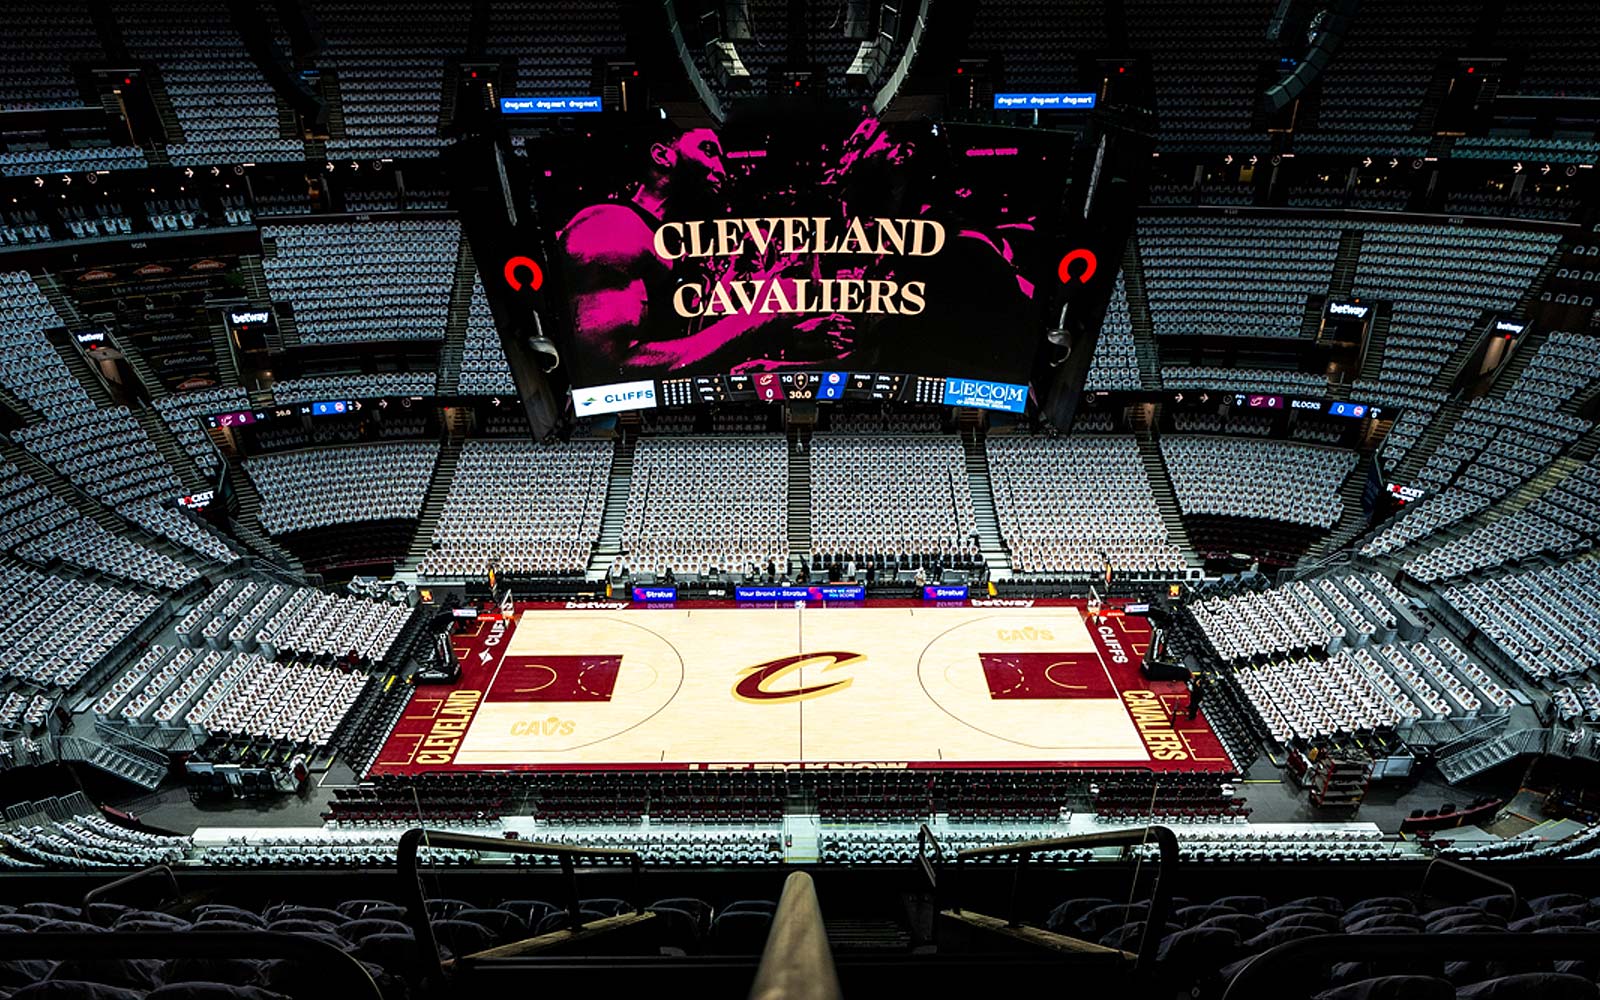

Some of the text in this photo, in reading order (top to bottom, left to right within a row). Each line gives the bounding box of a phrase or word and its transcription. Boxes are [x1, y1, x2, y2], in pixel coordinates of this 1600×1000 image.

[653, 216, 946, 260] CLEVELAND
[673, 278, 926, 318] CAVALIERS
[1330, 302, 1369, 318] betway
[231, 312, 269, 324] betway
[1496, 321, 1525, 334] betway
[77, 332, 104, 343] betway
[604, 390, 654, 403] CLIFFS
[766, 388, 774, 398] 0
[789, 390, 812, 399] 30.0
[827, 387, 835, 398] 0
[948, 381, 1024, 402] LECOM
[1268, 397, 1275, 407] 0
[1292, 400, 1321, 410] BLOCKS
[1337, 404, 1345, 414] 0
[239, 413, 246, 423] 0
[1386, 483, 1425, 499] ROCKET
[177, 490, 215, 507] ROCKET
[646, 590, 673, 599] Stratus
[937, 589, 964, 597] Stratus
[565, 601, 630, 610] betway
[971, 599, 1035, 608] betway
[996, 626, 1056, 641] CAVS
[1098, 626, 1129, 664] CLIFFS
[415, 689, 482, 765] CLEVELAND
[510, 717, 577, 737] CAVS
[1122, 690, 1189, 761] CAVALIERS
